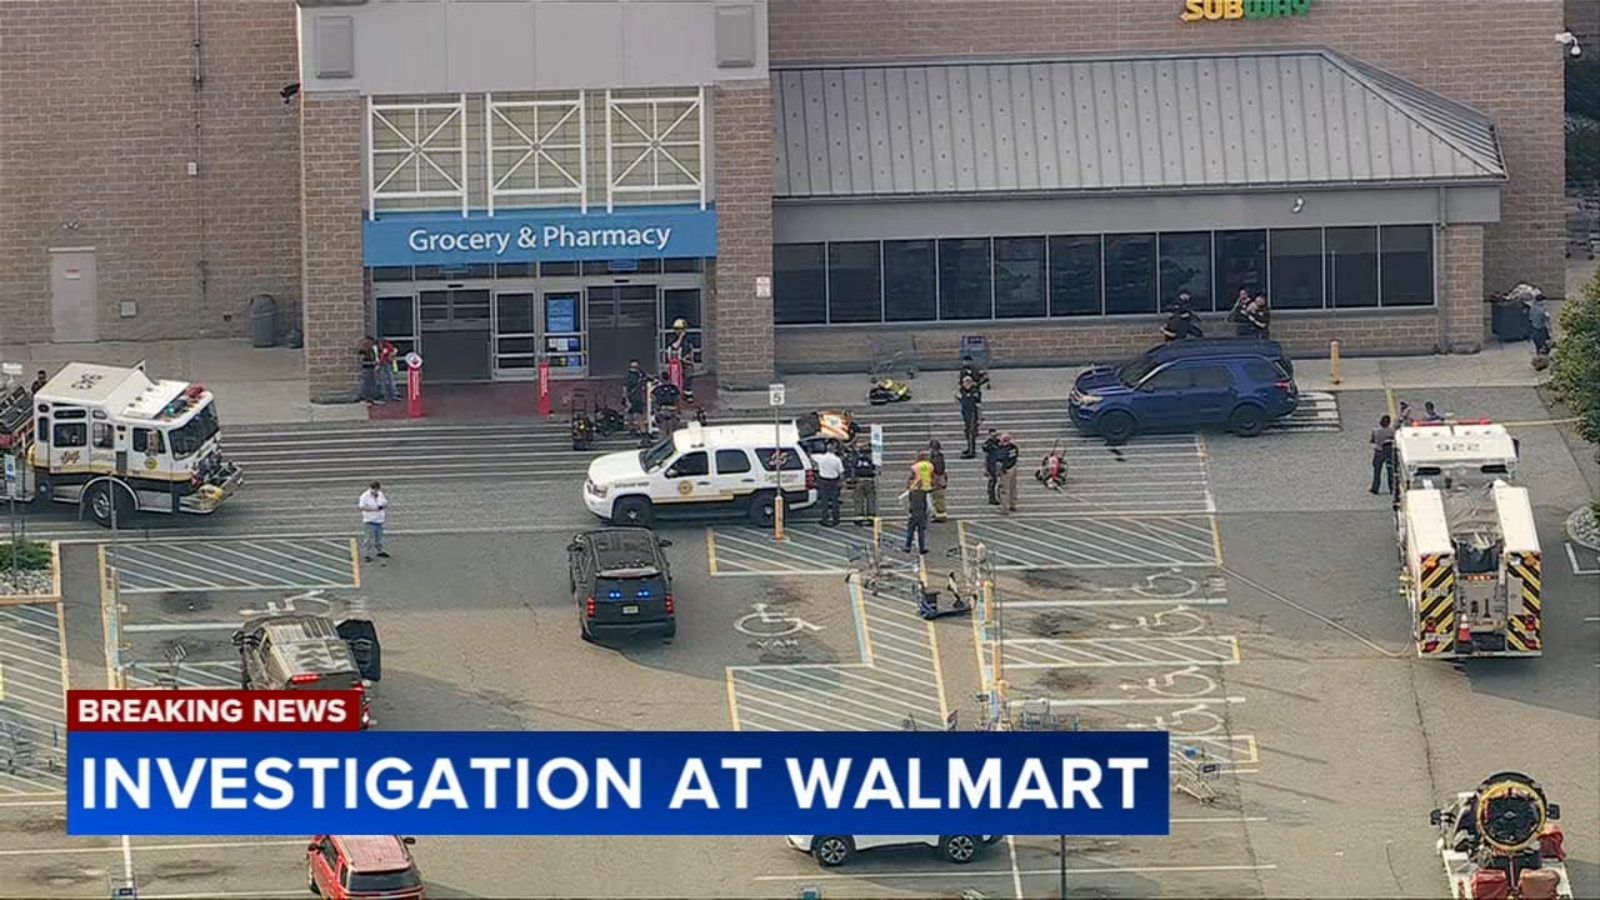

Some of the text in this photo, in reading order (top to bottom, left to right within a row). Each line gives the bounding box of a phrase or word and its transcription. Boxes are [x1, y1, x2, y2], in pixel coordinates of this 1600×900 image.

[1181, 0, 1312, 21] SUBWAY
[408, 224, 671, 254] Grocery & Pharmacy
